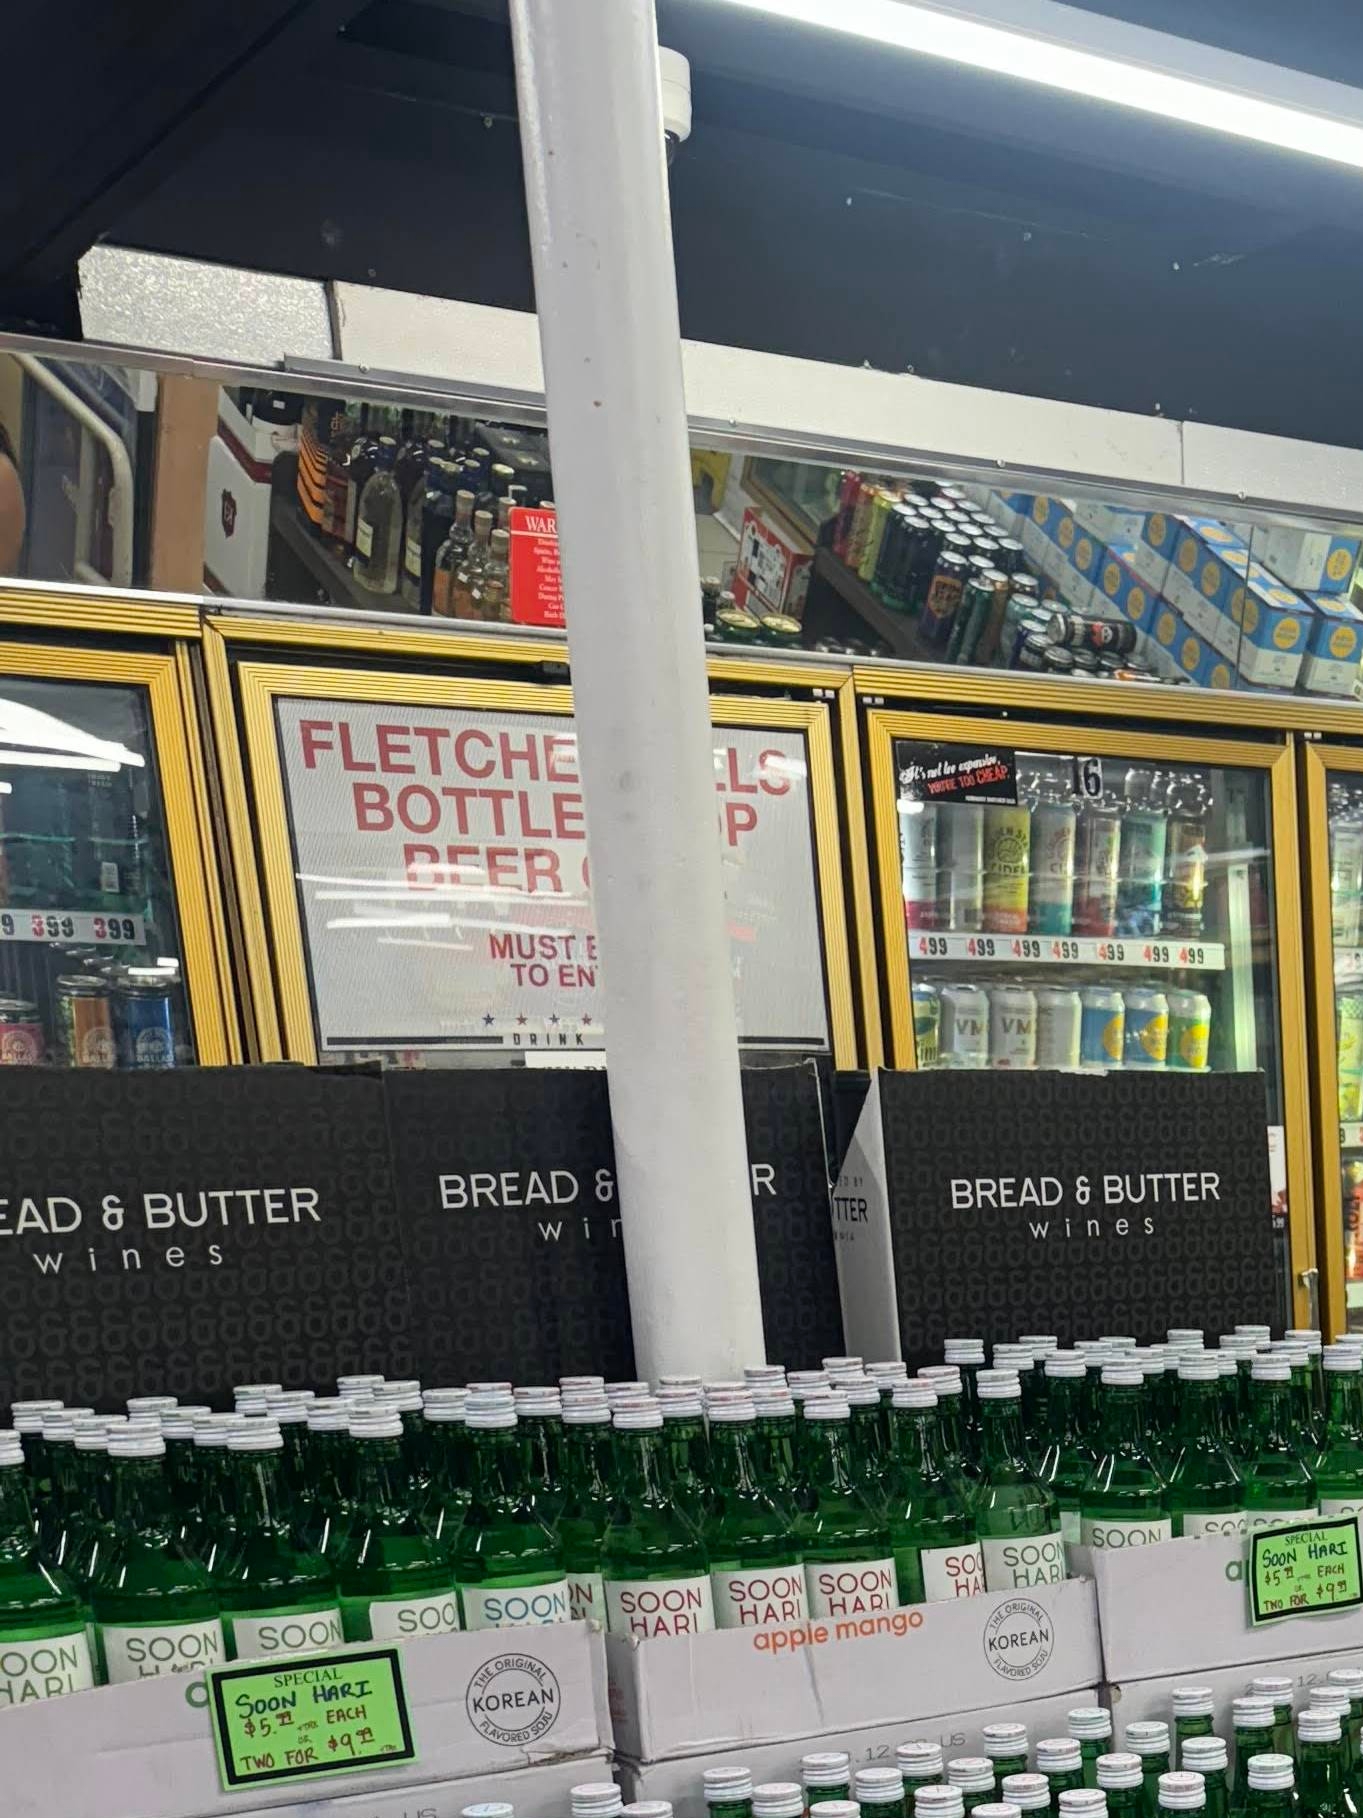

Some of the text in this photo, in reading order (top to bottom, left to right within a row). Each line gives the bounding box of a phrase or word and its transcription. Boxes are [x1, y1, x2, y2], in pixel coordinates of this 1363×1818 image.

[958, 774, 976, 788] TOO
[352, 782, 585, 839] BOTTLE
[404, 843, 561, 892] BEER
[94, 917, 135, 940] 399
[490, 934, 576, 959] MUST
[511, 964, 548, 987] TO
[513, 1033, 583, 1046] DRINK
[438, 1170, 579, 1209] BREAD
[951, 1172, 1220, 1209] BREAD & BUTTER
[103, 1196, 124, 1230] &
[145, 1188, 321, 1229] BUTTER
[1029, 1216, 1154, 1239] wines
[33, 1242, 223, 1275] wines
[1285, 1531, 1328, 1545] SPECIAL
[1318, 1563, 1344, 1577] EACH
[729, 1576, 800, 1601] SOON
[820, 1570, 891, 1596] SOON
[622, 1588, 701, 1613] SOON
[1004, 1603, 1044, 1621] ORIGINAL
[1264, 1594, 1309, 1611] TWO FOR
[754, 1611, 923, 1653] apple mango
[989, 1629, 1049, 1651] KOREAN
[127, 1632, 218, 1664] SOON
[274, 1668, 343, 1688] SPECIAL
[495, 1657, 548, 1687] ORIGINAL
[313, 1680, 372, 1703] HARI
[472, 1688, 554, 1713] KOREAN
[327, 1705, 367, 1724] EACH
[240, 1753, 275, 1770] TWO
[285, 1747, 318, 1765] FOR
